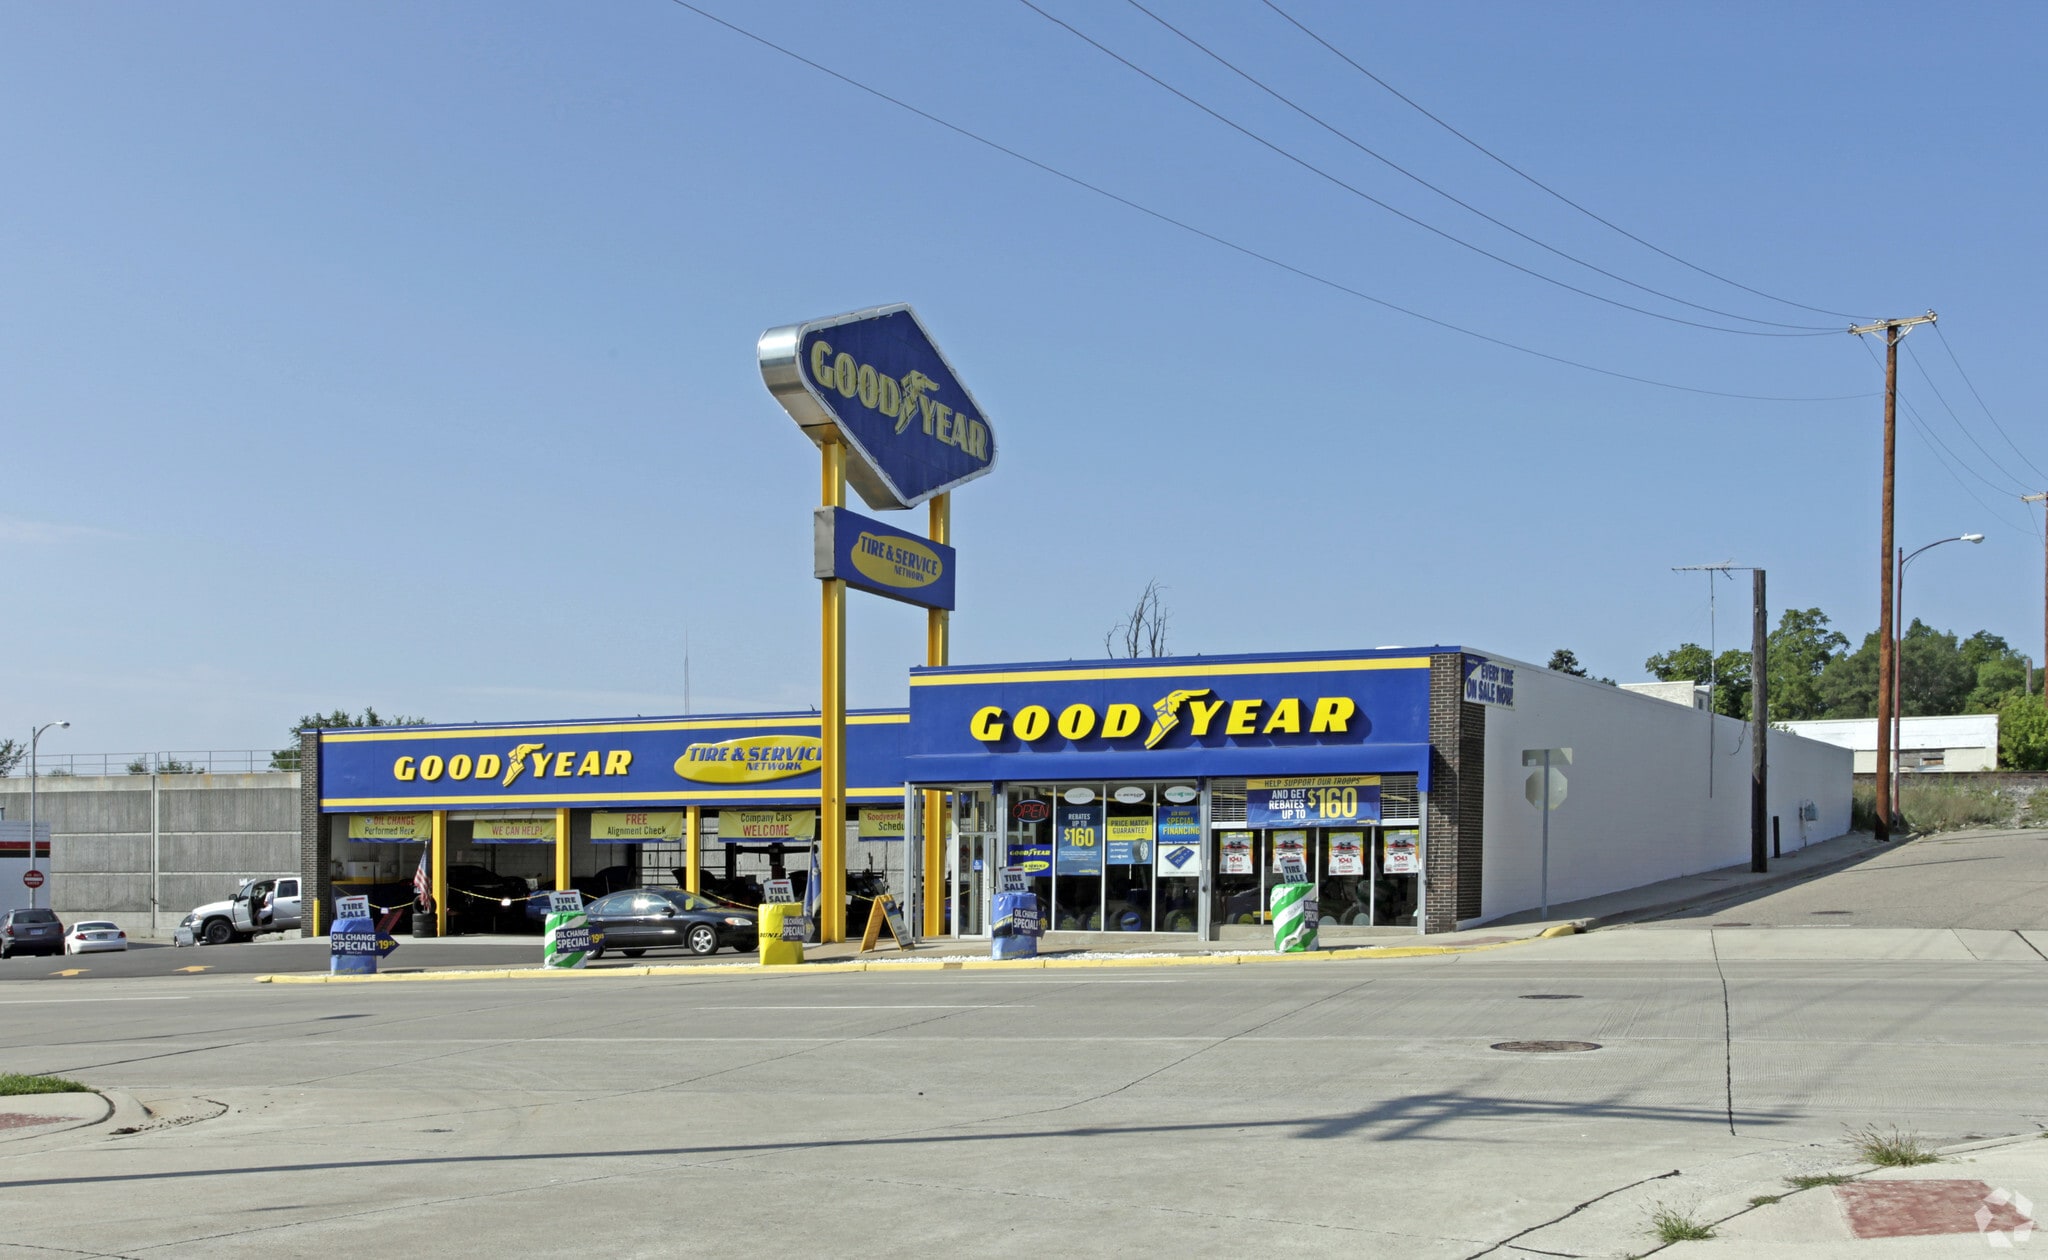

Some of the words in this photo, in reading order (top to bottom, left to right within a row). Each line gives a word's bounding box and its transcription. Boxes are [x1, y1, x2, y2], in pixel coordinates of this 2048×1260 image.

[861, 536, 885, 558] TIRE
[886, 545, 895, 562] &
[895, 548, 938, 576] SERVICE
[894, 565, 925, 583] NETWORK
[1481, 663, 1499, 682] EVERY
[1501, 667, 1514, 687] TIRE
[1467, 677, 1477, 700] ON
[1478, 680, 1495, 704] SALE
[689, 747, 729, 761] TIRE
[731, 747, 745, 761] &
[746, 762, 802, 771] NETWORK
[1284, 778, 1315, 787] SUPPORT
[1317, 777, 1331, 785] OUR
[1272, 789, 1288, 799] AND
[1290, 789, 1306, 799] GET
[1269, 800, 1304, 809] REBATES
[1308, 787, 1358, 819] $160
[1013, 804, 1050, 819] OPEN
[1282, 810, 1294, 819] UP
[1296, 809, 1306, 819] TO
[374, 816, 384, 825] OIL
[387, 815, 415, 825] CHANGE
[626, 813, 648, 825] FREE
[740, 813, 774, 823] Company
[775, 812, 793, 821] Cars
[1167, 817, 1194, 825] SPECIAL
[365, 827, 398, 835] Performed
[399, 827, 415, 835] Here
[492, 826, 503, 835] WE
[505, 826, 520, 835] CAN
[521, 826, 543, 835] HELP!
[607, 826, 642, 836] Alignment
[644, 826, 666, 834] Check
[742, 824, 790, 836] WELCOME
[1163, 826, 1200, 835] FINANCING
[1064, 827, 1095, 847] $160
[1284, 865, 1300, 873] TIRE
[1285, 874, 1304, 882] SALE
[1004, 883, 1025, 891] SALE
[342, 902, 363, 910] TIRE
[555, 897, 576, 905] TIRE
[341, 910, 366, 918] SALE
[1014, 918, 1038, 930] SPECIAL!
[566, 929, 589, 938] CHANGE
[332, 941, 376, 951] SPECIAL!
[557, 936, 590, 949] SPECIAL!
